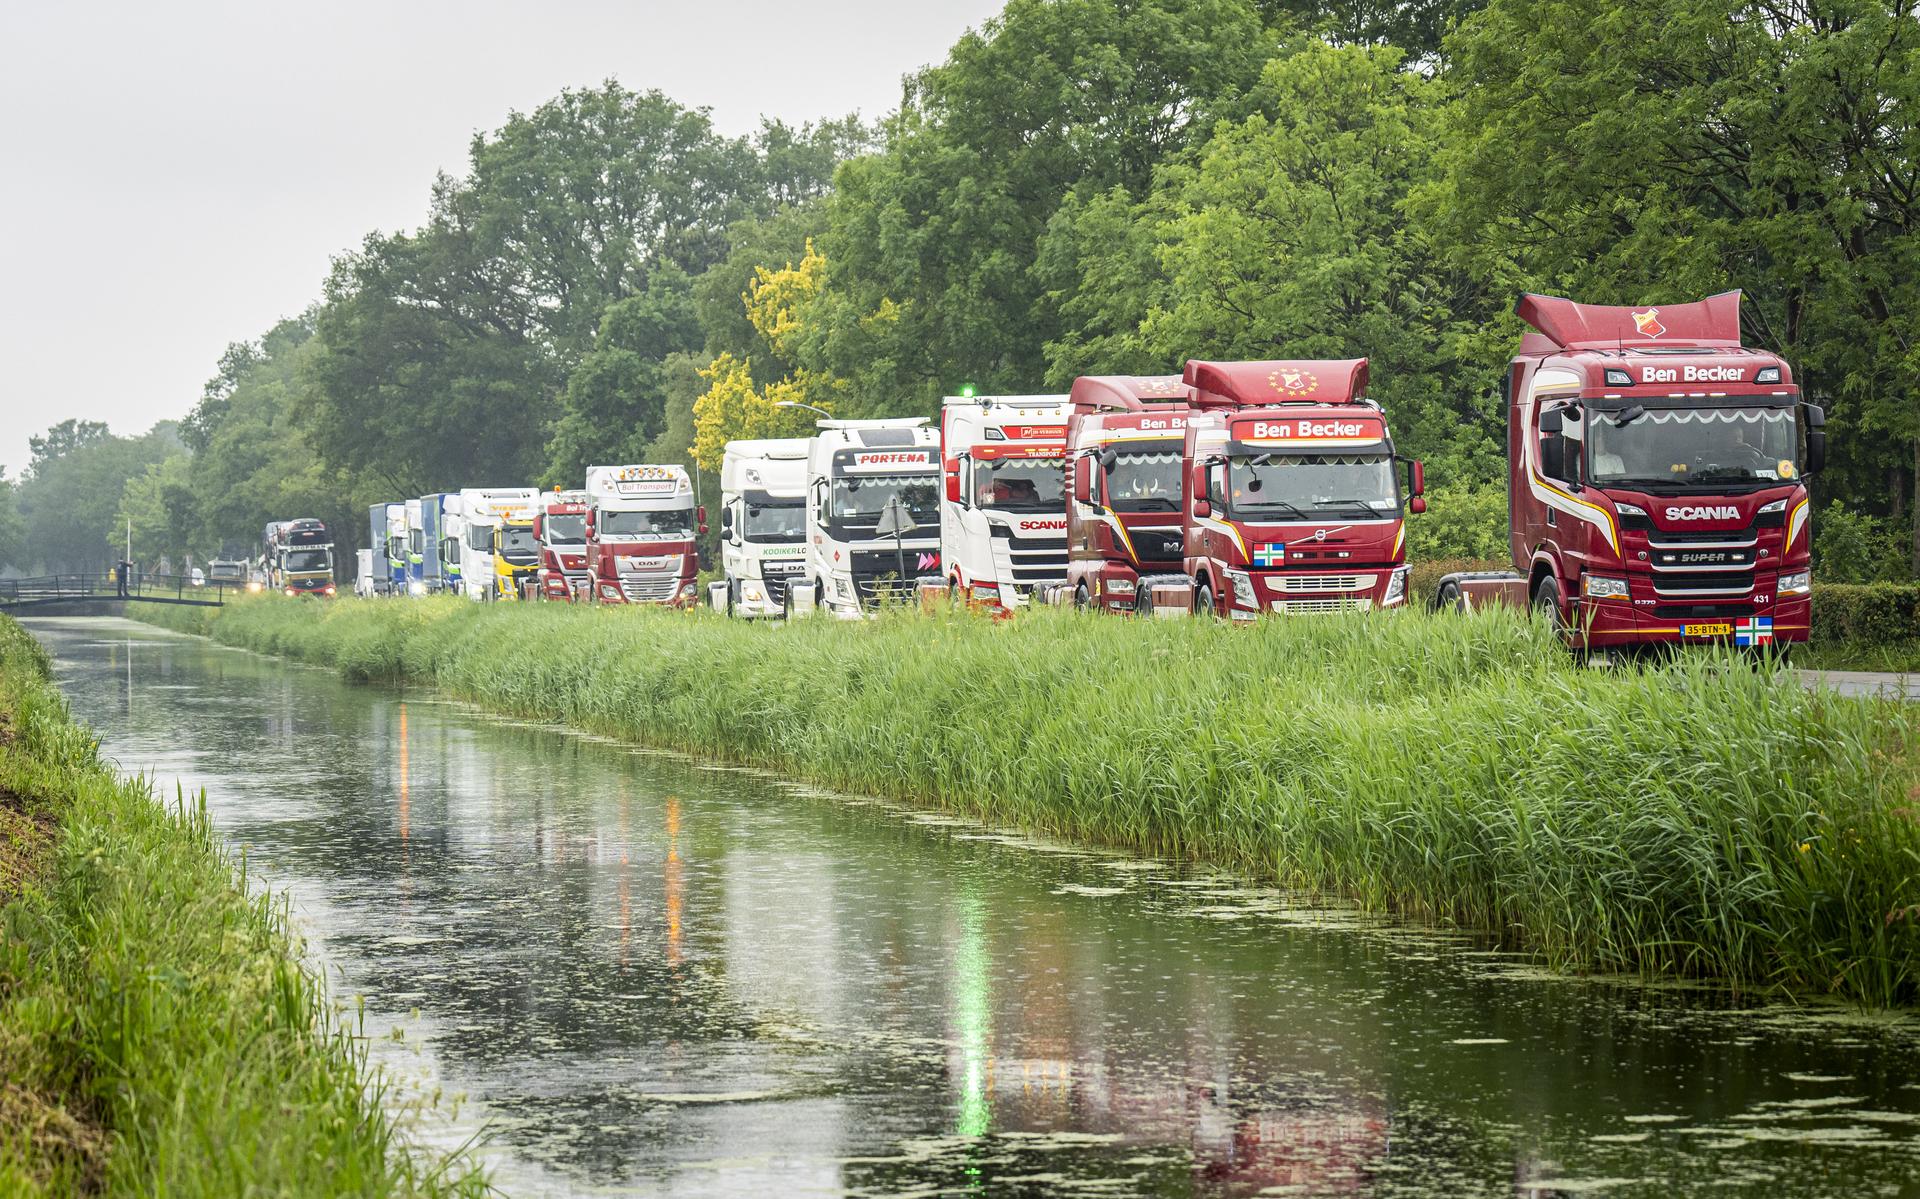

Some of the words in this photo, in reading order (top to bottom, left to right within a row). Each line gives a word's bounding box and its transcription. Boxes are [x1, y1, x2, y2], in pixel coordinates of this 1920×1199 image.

[1642, 366, 1677, 382] Ben
[1683, 365, 1745, 382] Becker
[1140, 418, 1167, 429] Ben
[1254, 422, 1291, 438] Ben
[1298, 421, 1364, 437] Becker
[860, 453, 925, 464] PORTENA
[636, 483, 672, 491] Transport
[1665, 506, 1741, 520] SCANIA
[1681, 553, 1725, 562] SUPER
[1753, 595, 1769, 604] 431
[1687, 625, 1727, 635] 35-BTN-4
